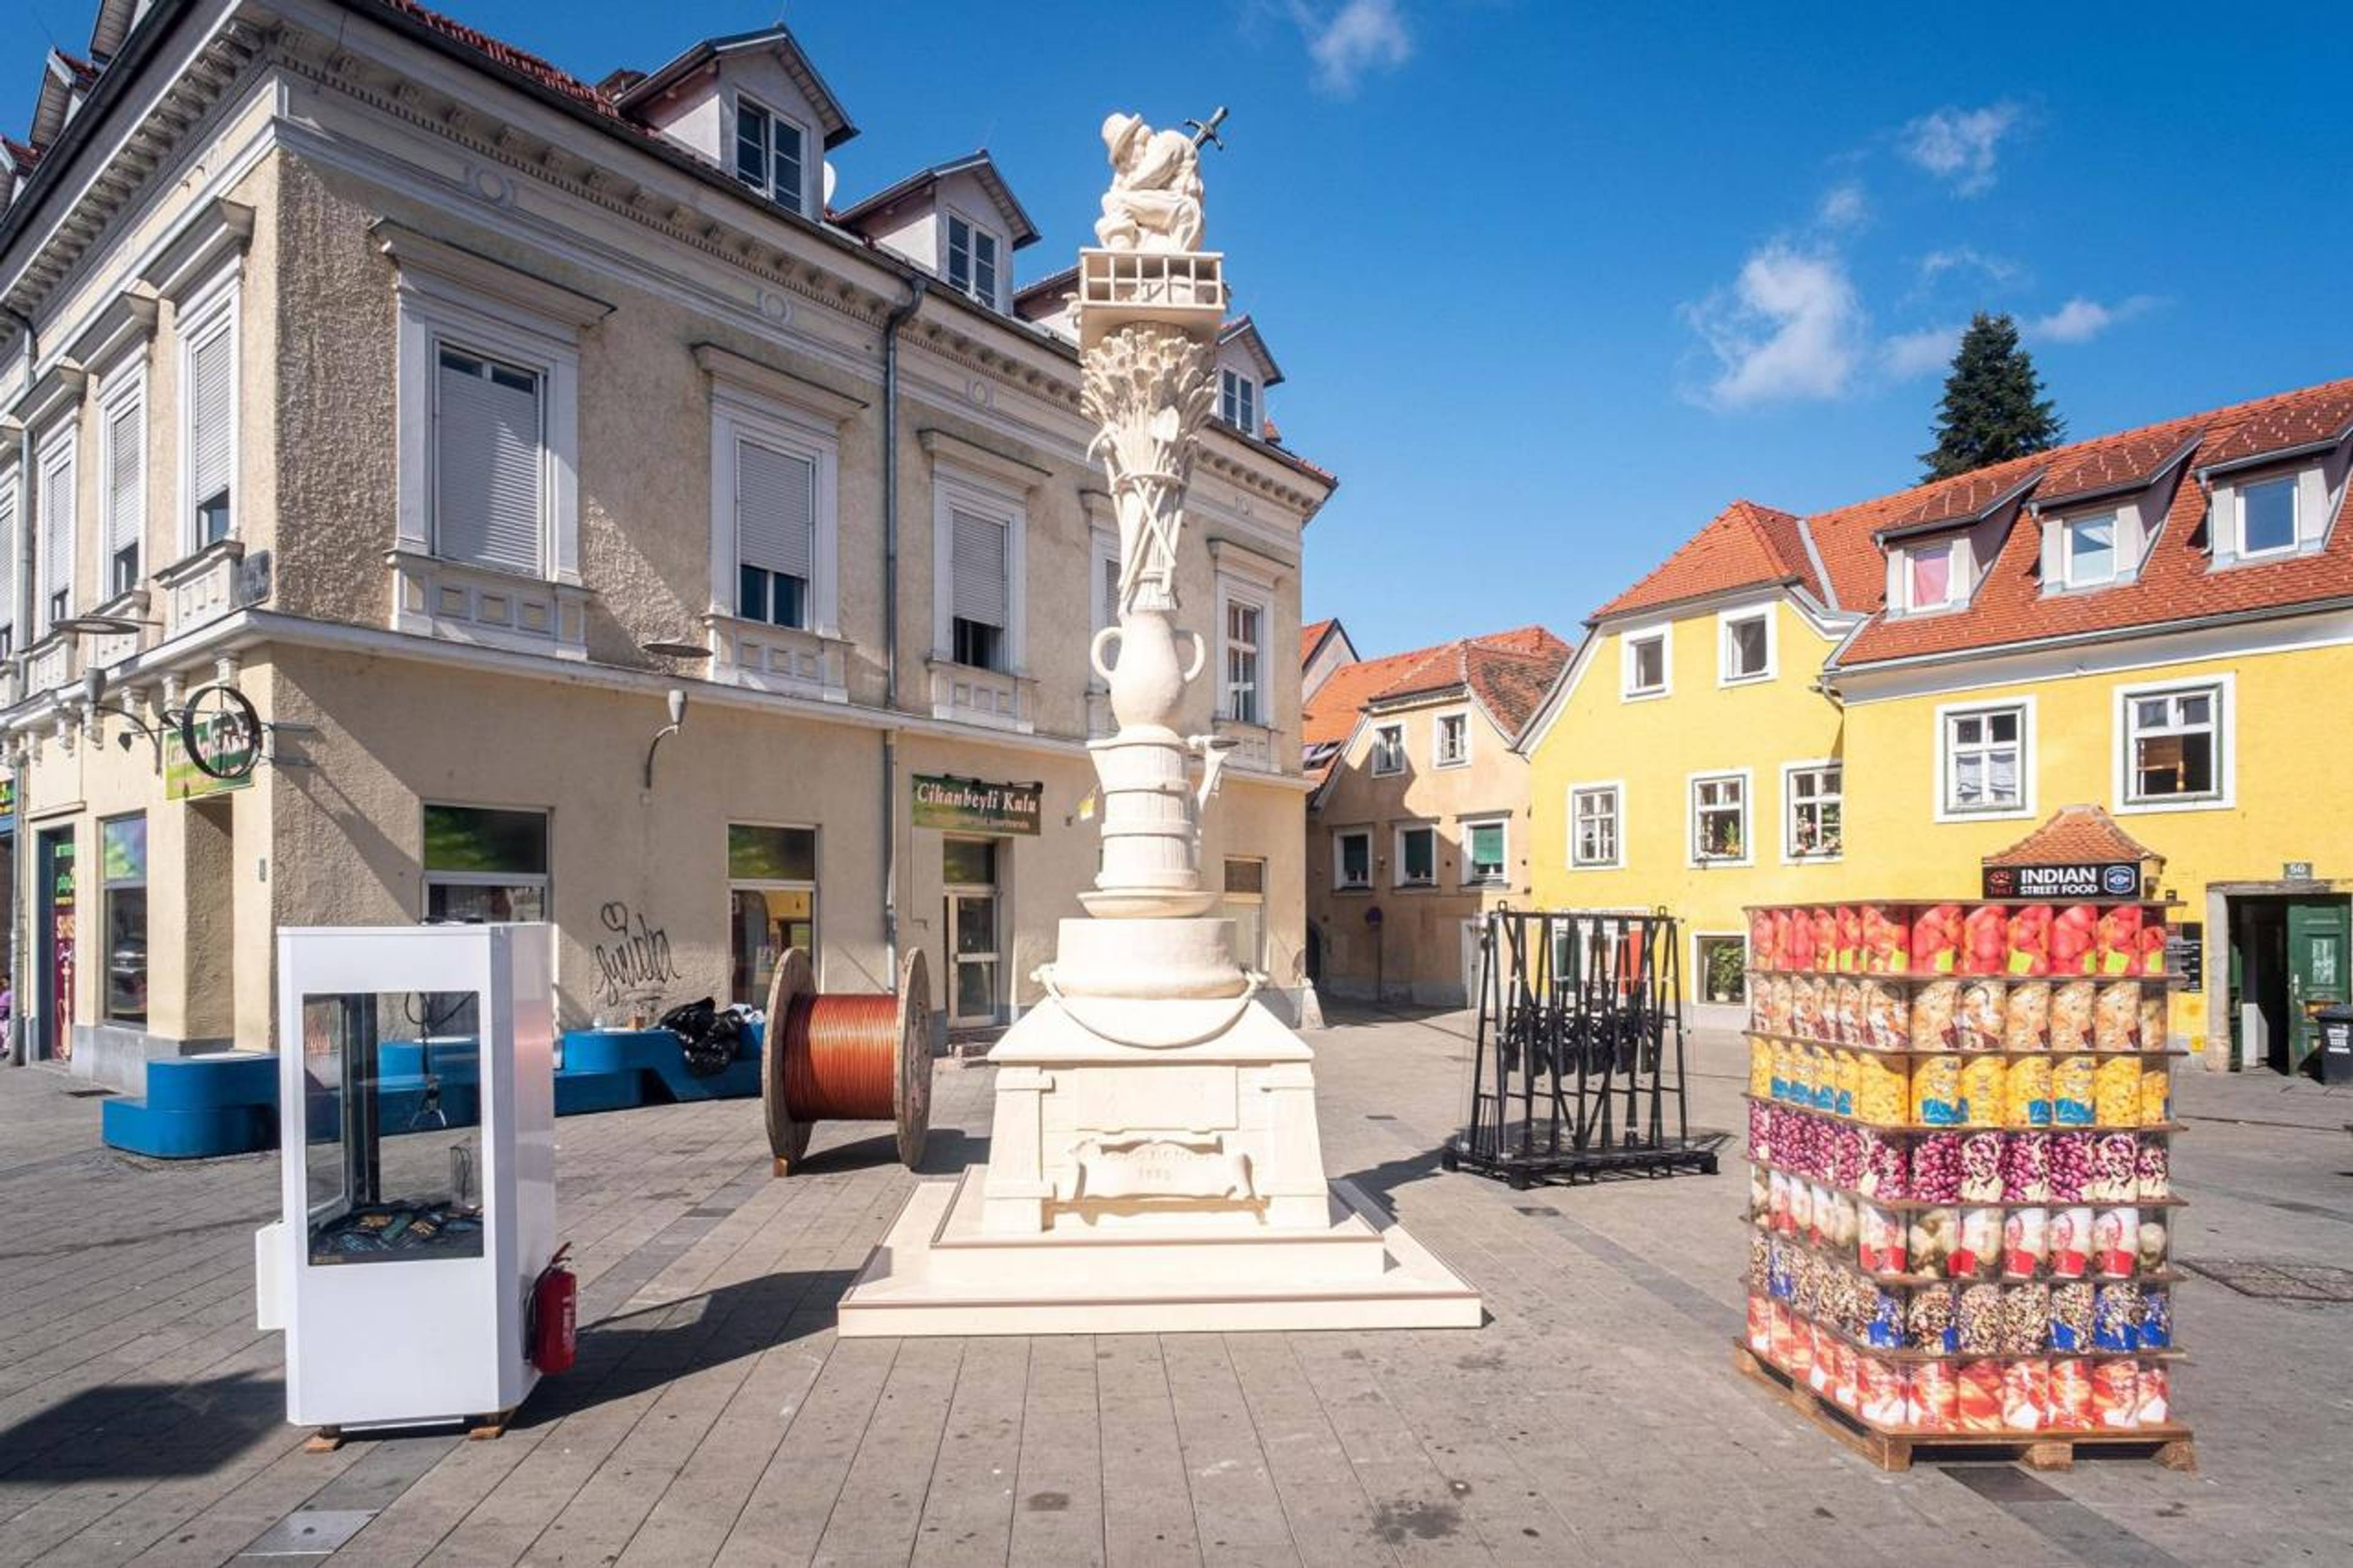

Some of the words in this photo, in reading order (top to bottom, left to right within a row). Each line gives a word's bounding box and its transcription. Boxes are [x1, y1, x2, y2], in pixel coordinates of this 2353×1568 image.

[2021, 868, 2097, 884] INDIAN
[2020, 885, 2059, 895] STREET
[2062, 884, 2098, 894] FOOD
